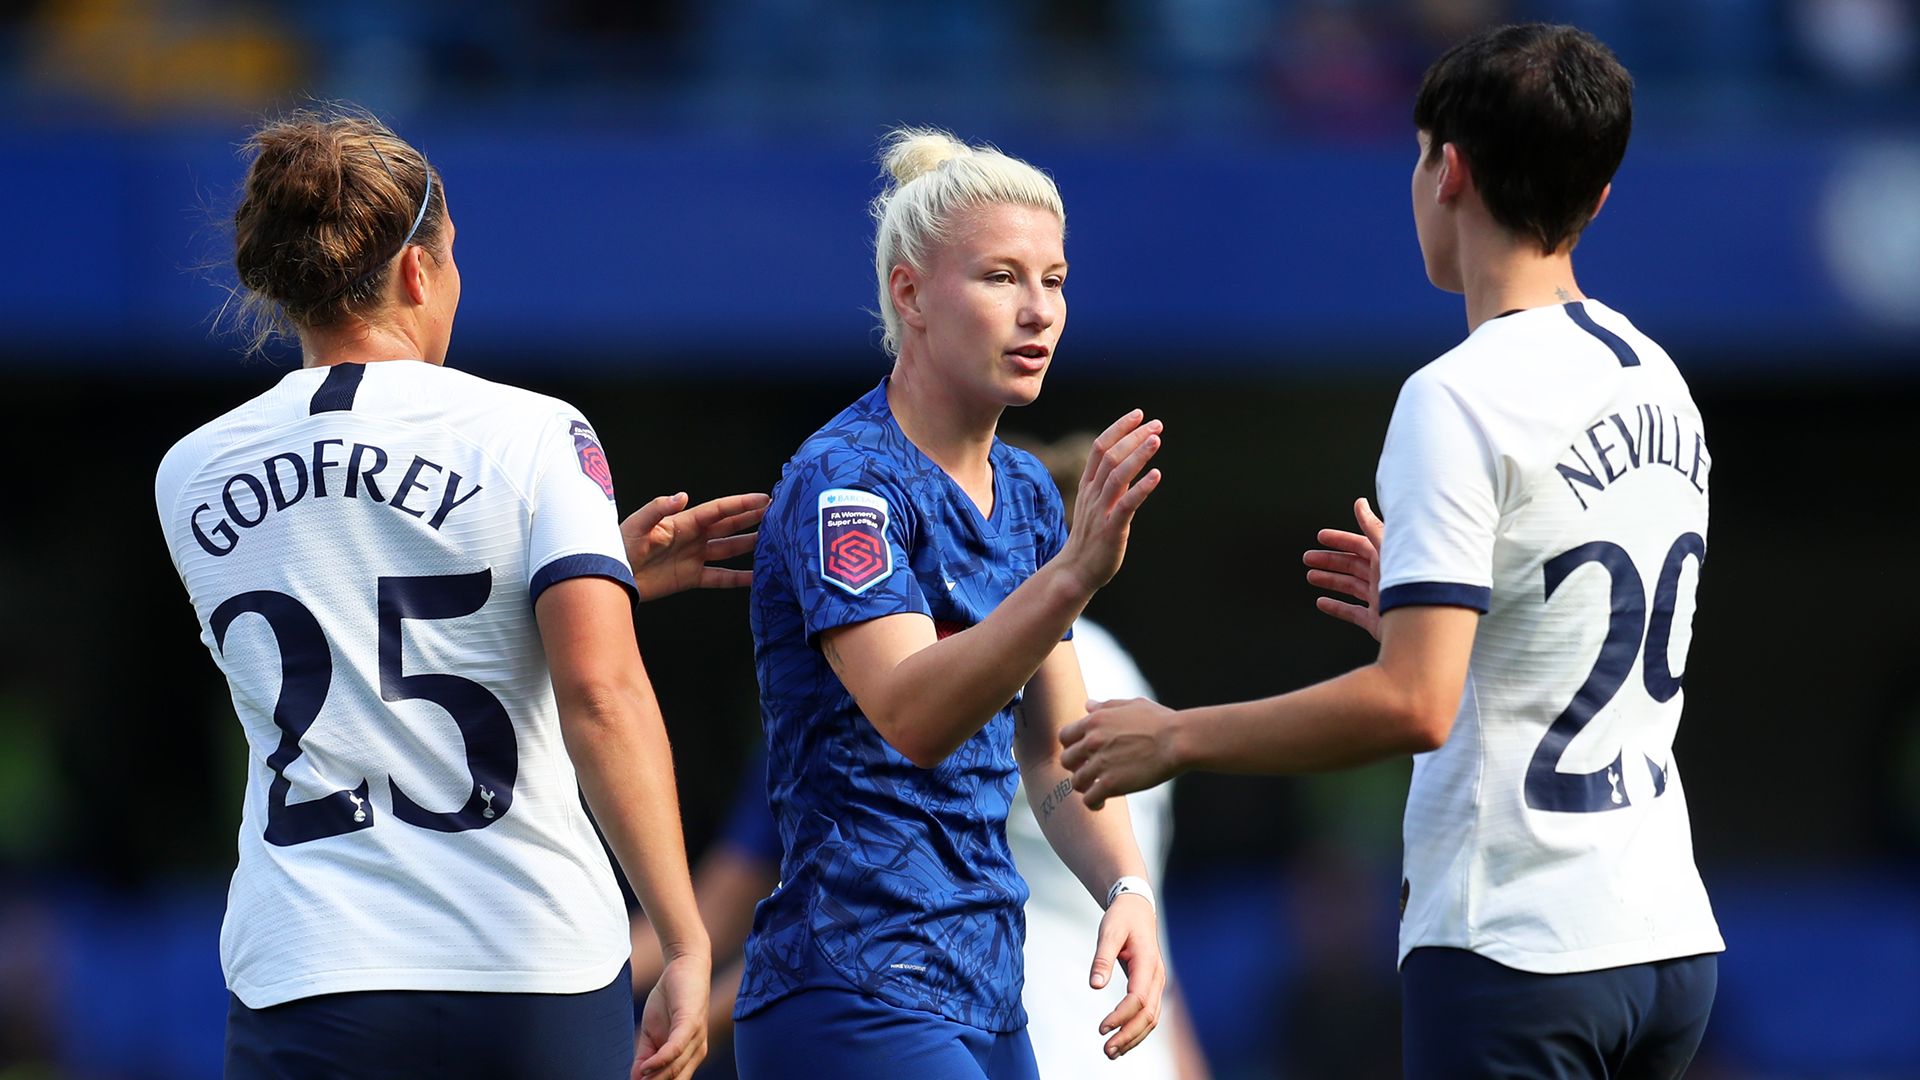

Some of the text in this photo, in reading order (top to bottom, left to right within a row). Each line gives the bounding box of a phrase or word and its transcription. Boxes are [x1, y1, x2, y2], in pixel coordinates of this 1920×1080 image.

[190, 438, 483, 557] GODFREY
[837, 494, 880, 507] BARCLA
[1555, 403, 1711, 511] NEVILLE
[827, 519, 851, 527] Super
[841, 511, 877, 520] Women's
[209, 568, 518, 847] 25
[1524, 531, 1705, 814] 29
